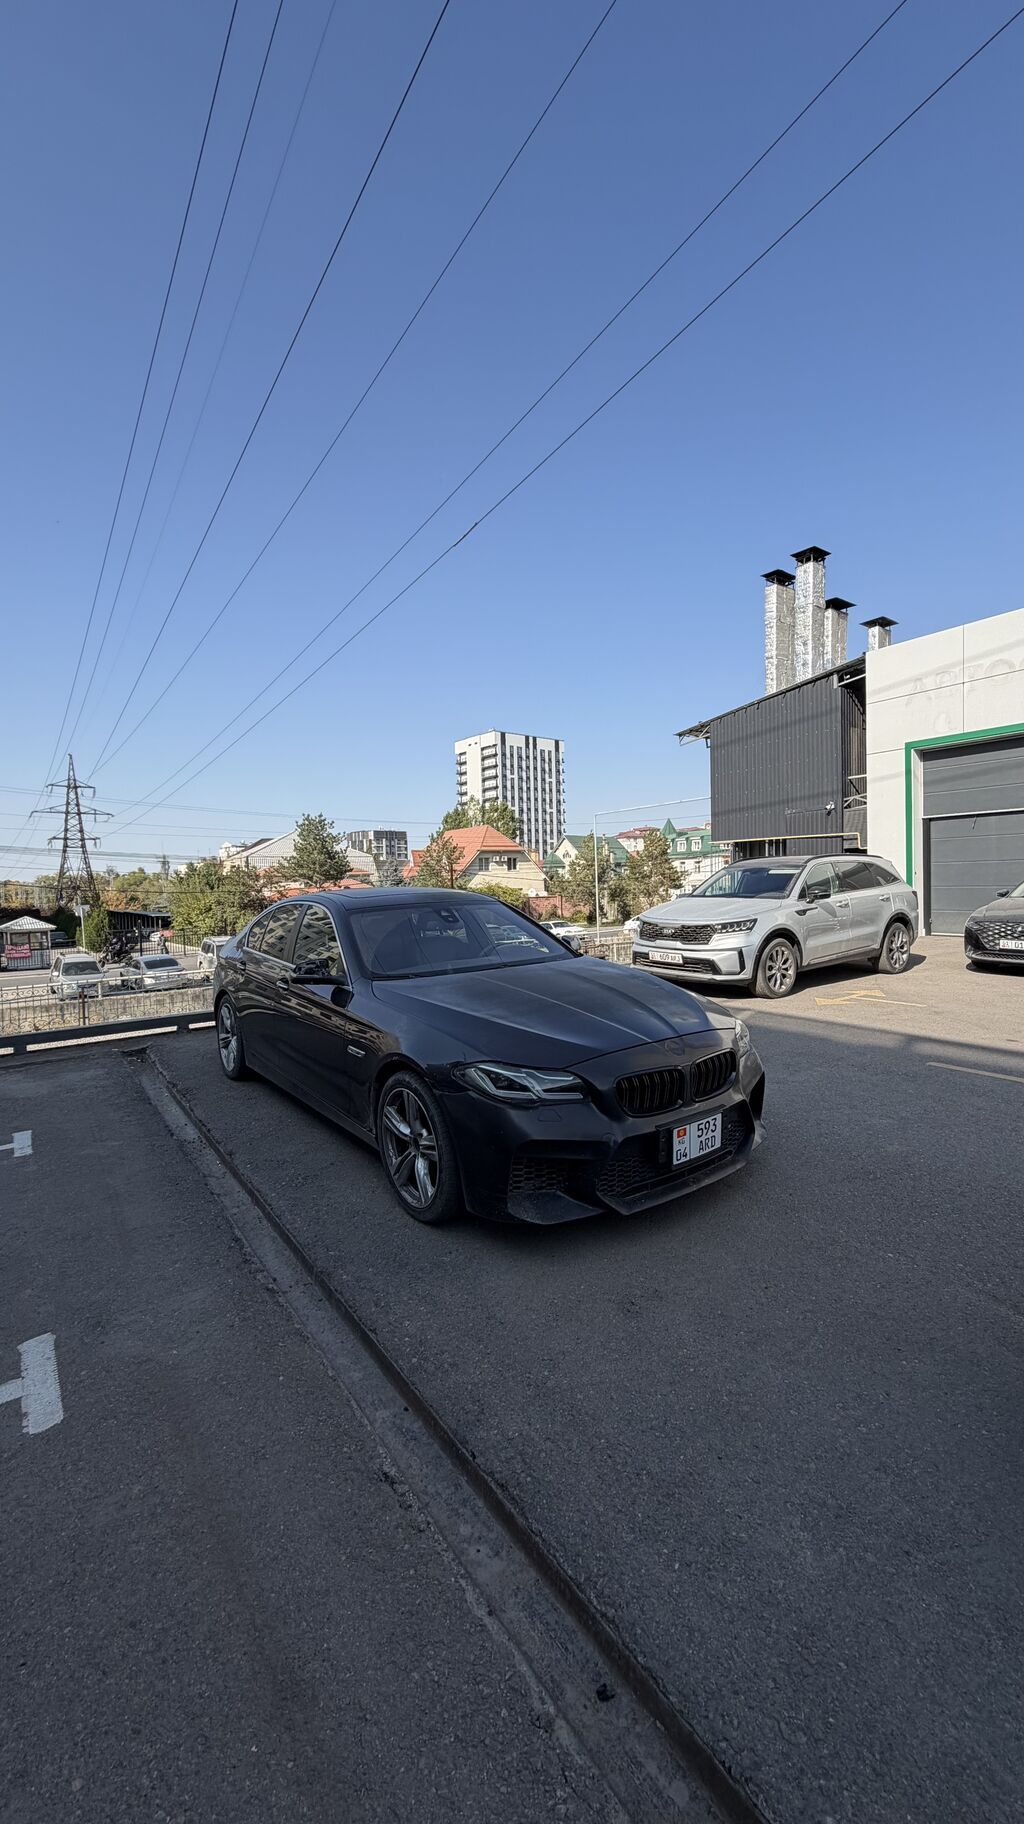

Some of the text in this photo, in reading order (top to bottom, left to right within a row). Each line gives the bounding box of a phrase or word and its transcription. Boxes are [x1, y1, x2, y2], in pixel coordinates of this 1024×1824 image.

[697, 1117, 717, 1138] 593
[675, 1147, 688, 1161] 04
[698, 1135, 716, 1154] ARD
